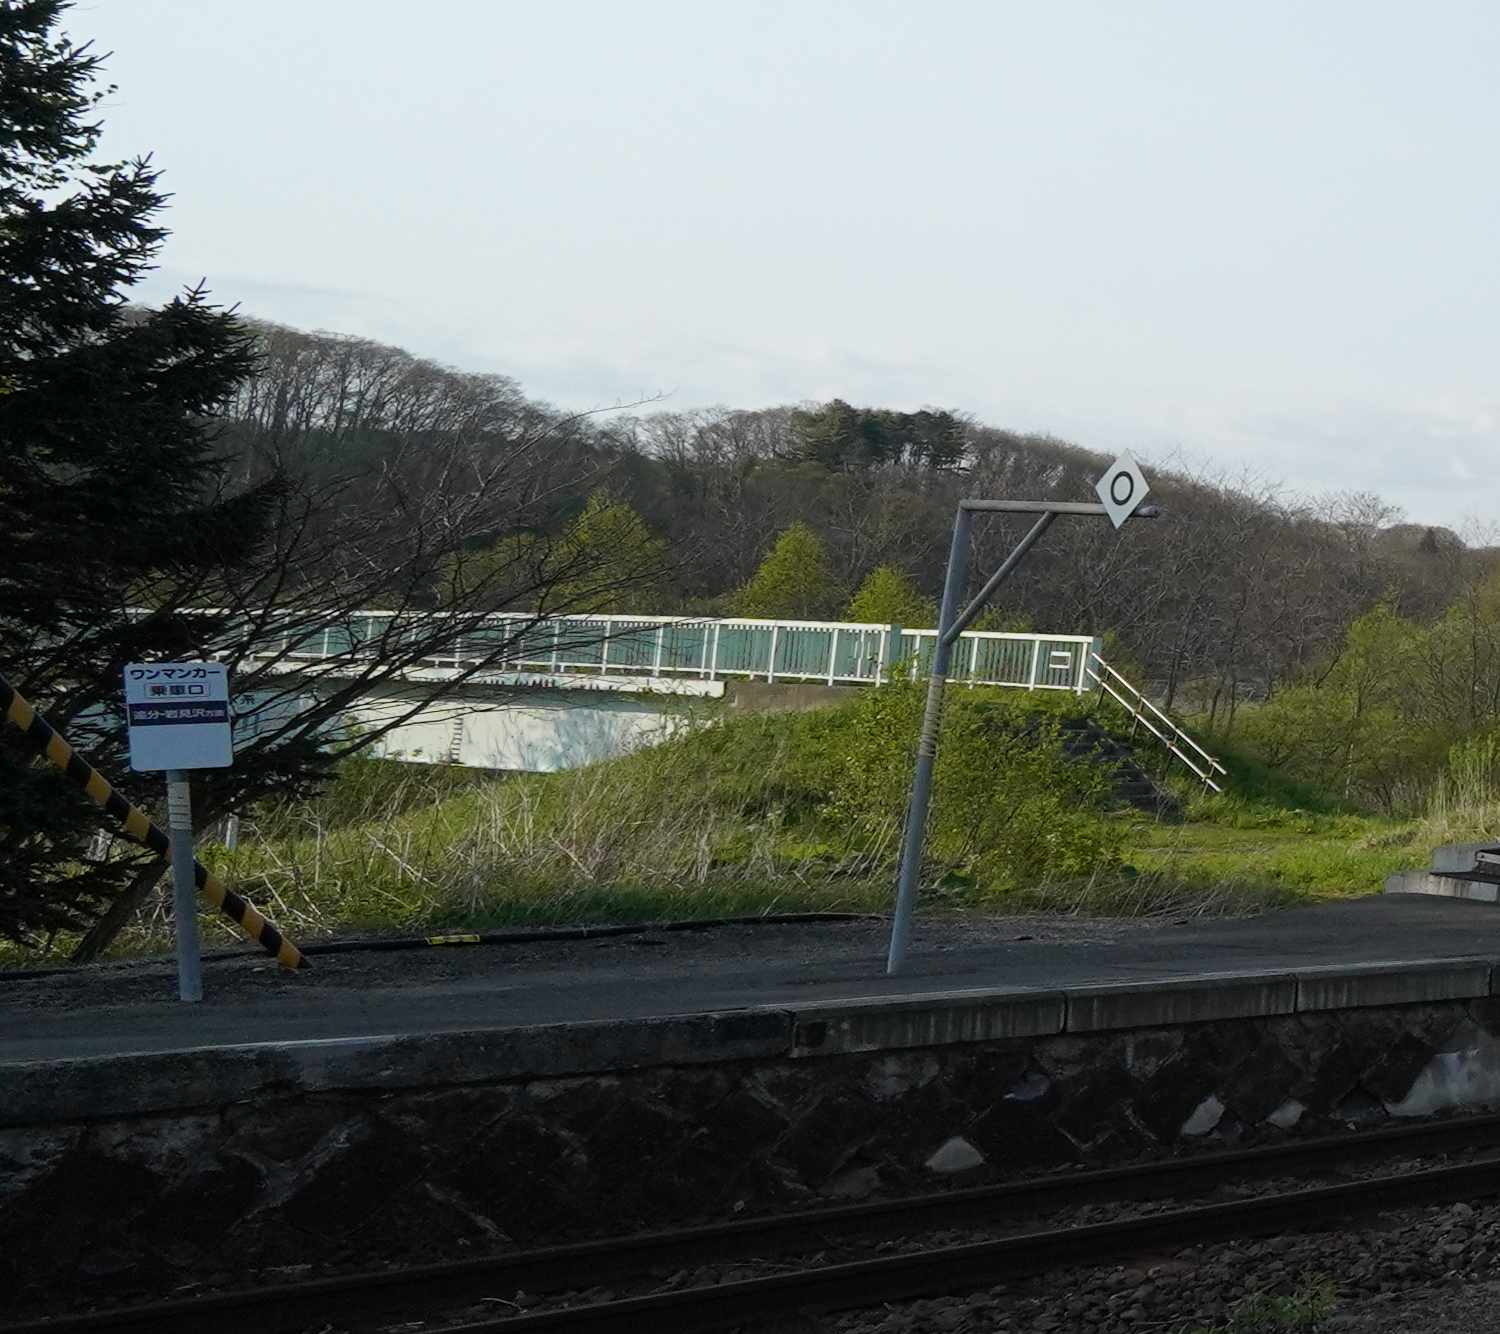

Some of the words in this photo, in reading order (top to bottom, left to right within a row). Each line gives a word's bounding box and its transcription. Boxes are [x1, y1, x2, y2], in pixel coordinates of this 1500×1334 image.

[130, 667, 221, 680] ワンマンカー
[150, 684, 205, 697] 乗車口
